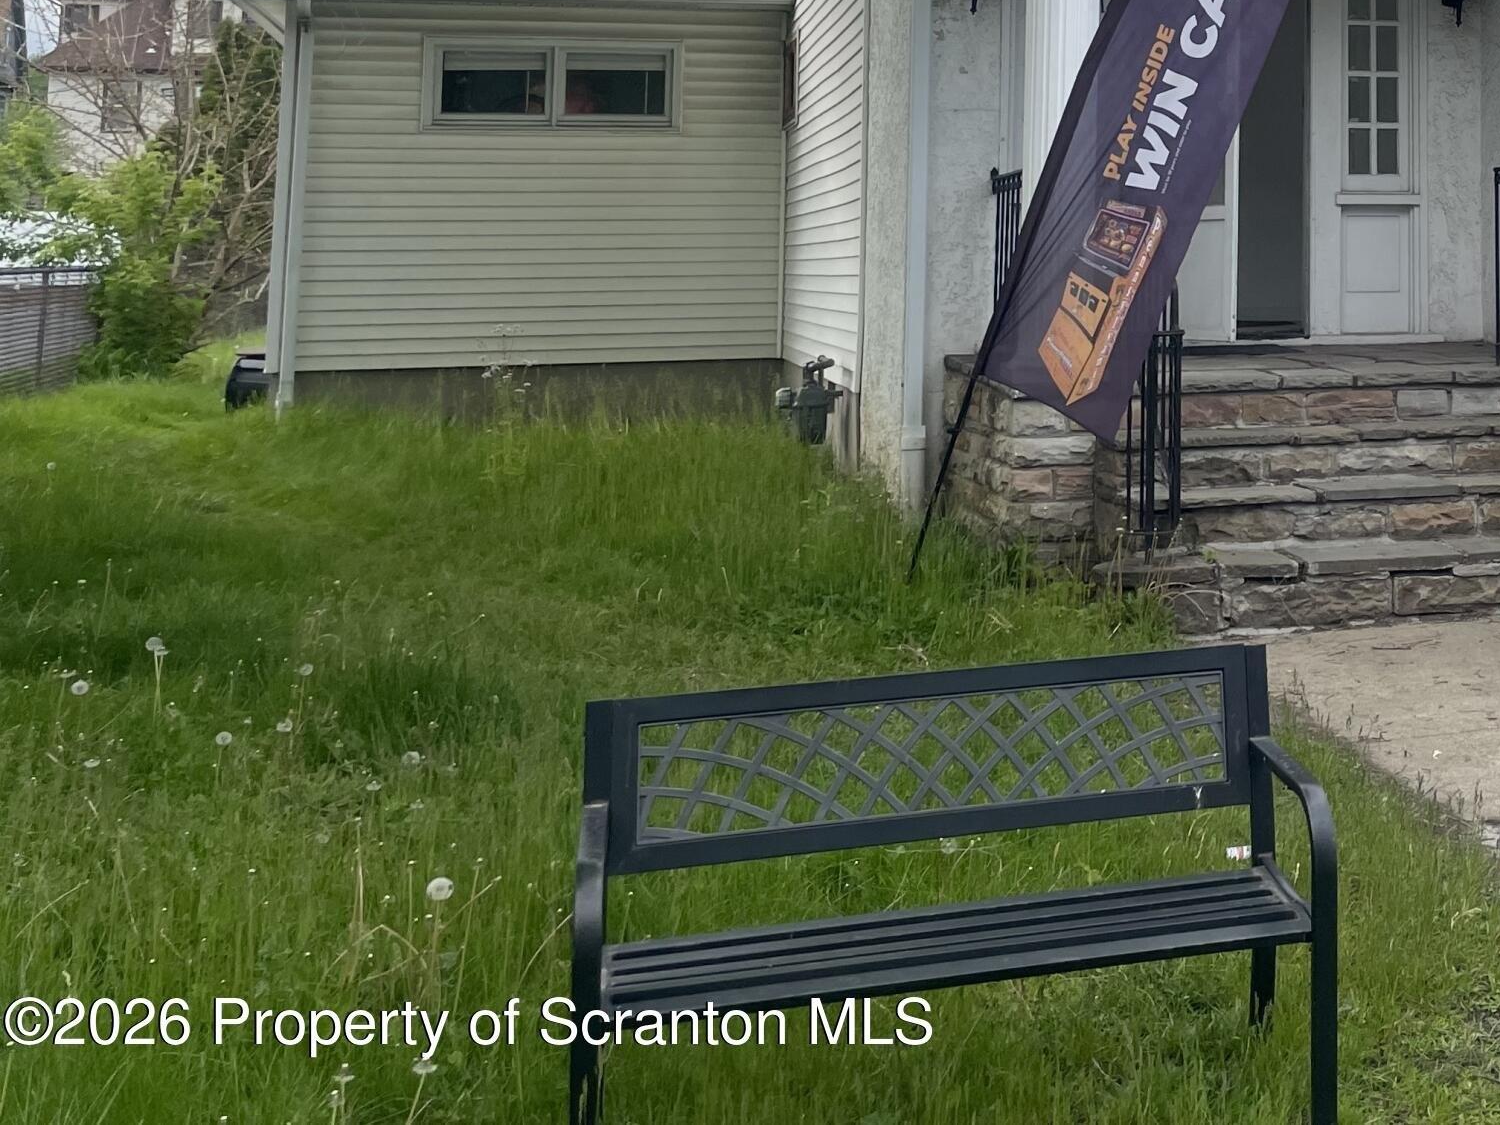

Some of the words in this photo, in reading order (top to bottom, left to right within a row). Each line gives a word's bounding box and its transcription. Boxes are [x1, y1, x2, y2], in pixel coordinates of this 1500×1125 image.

[1103, 113, 1137, 180] PLAY
[1132, 24, 1175, 112] INSIDE
[1124, 68, 1199, 190] WIN
